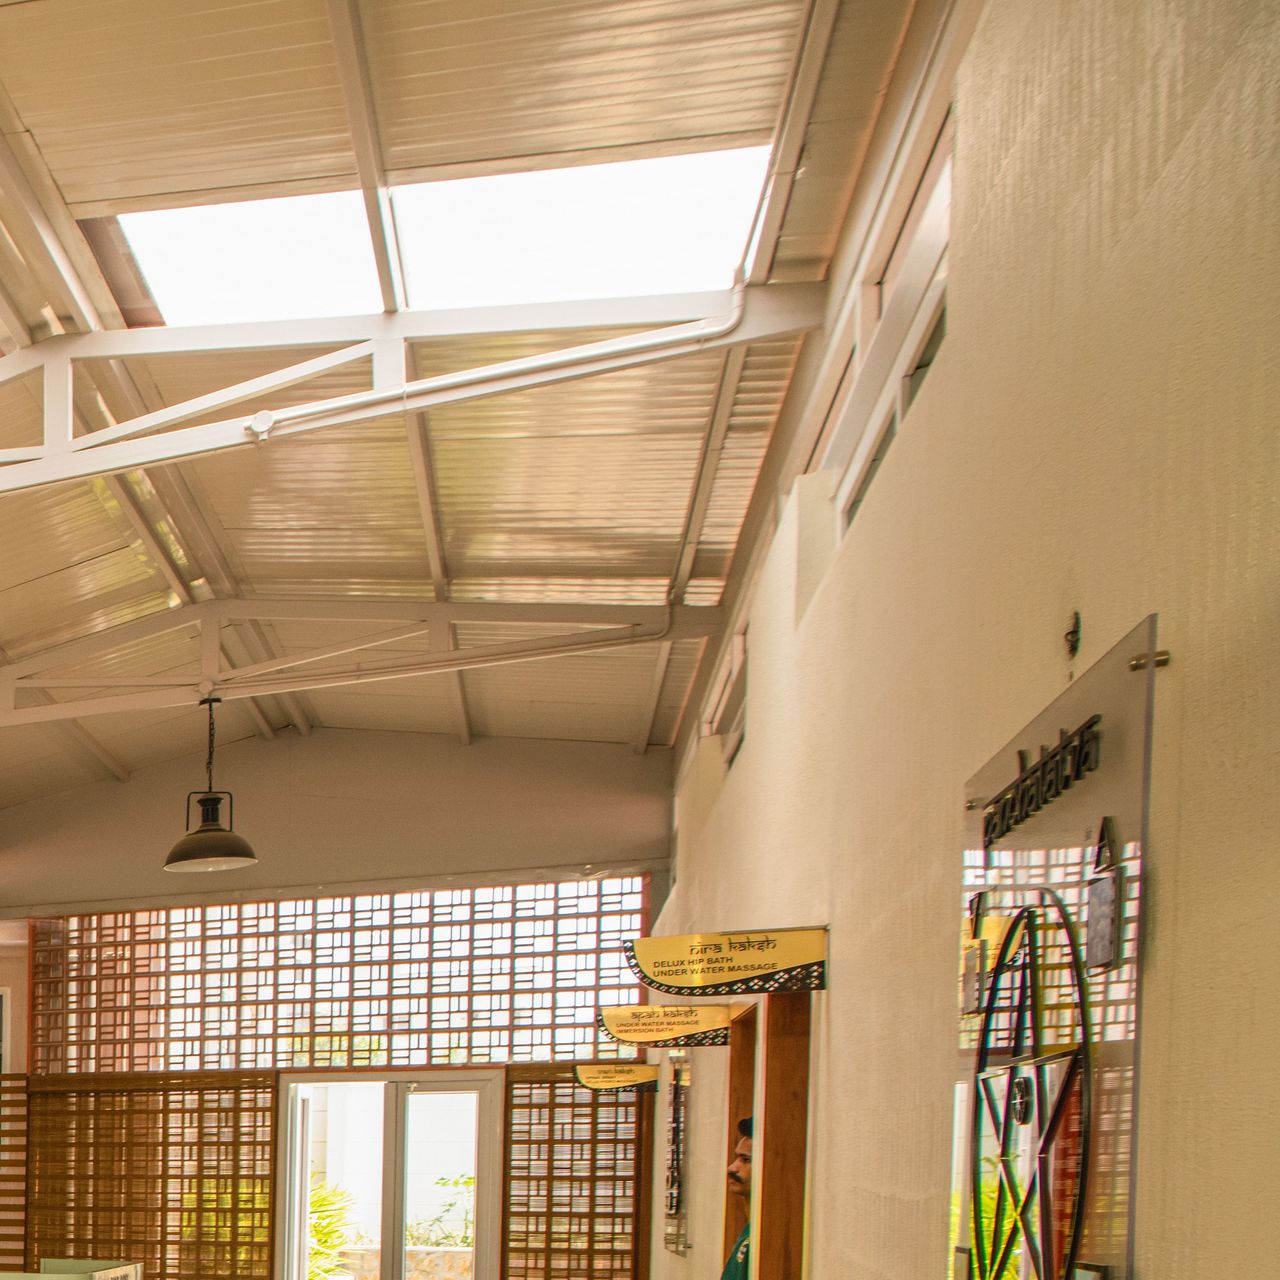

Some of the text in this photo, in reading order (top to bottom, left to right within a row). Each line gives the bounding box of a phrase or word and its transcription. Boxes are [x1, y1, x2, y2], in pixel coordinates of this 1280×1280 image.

[689, 934, 777, 955] nira kaksh
[652, 962, 779, 977] UNDER WATER MASSAGE
[653, 956, 733, 968] DELUX HIP BATH
